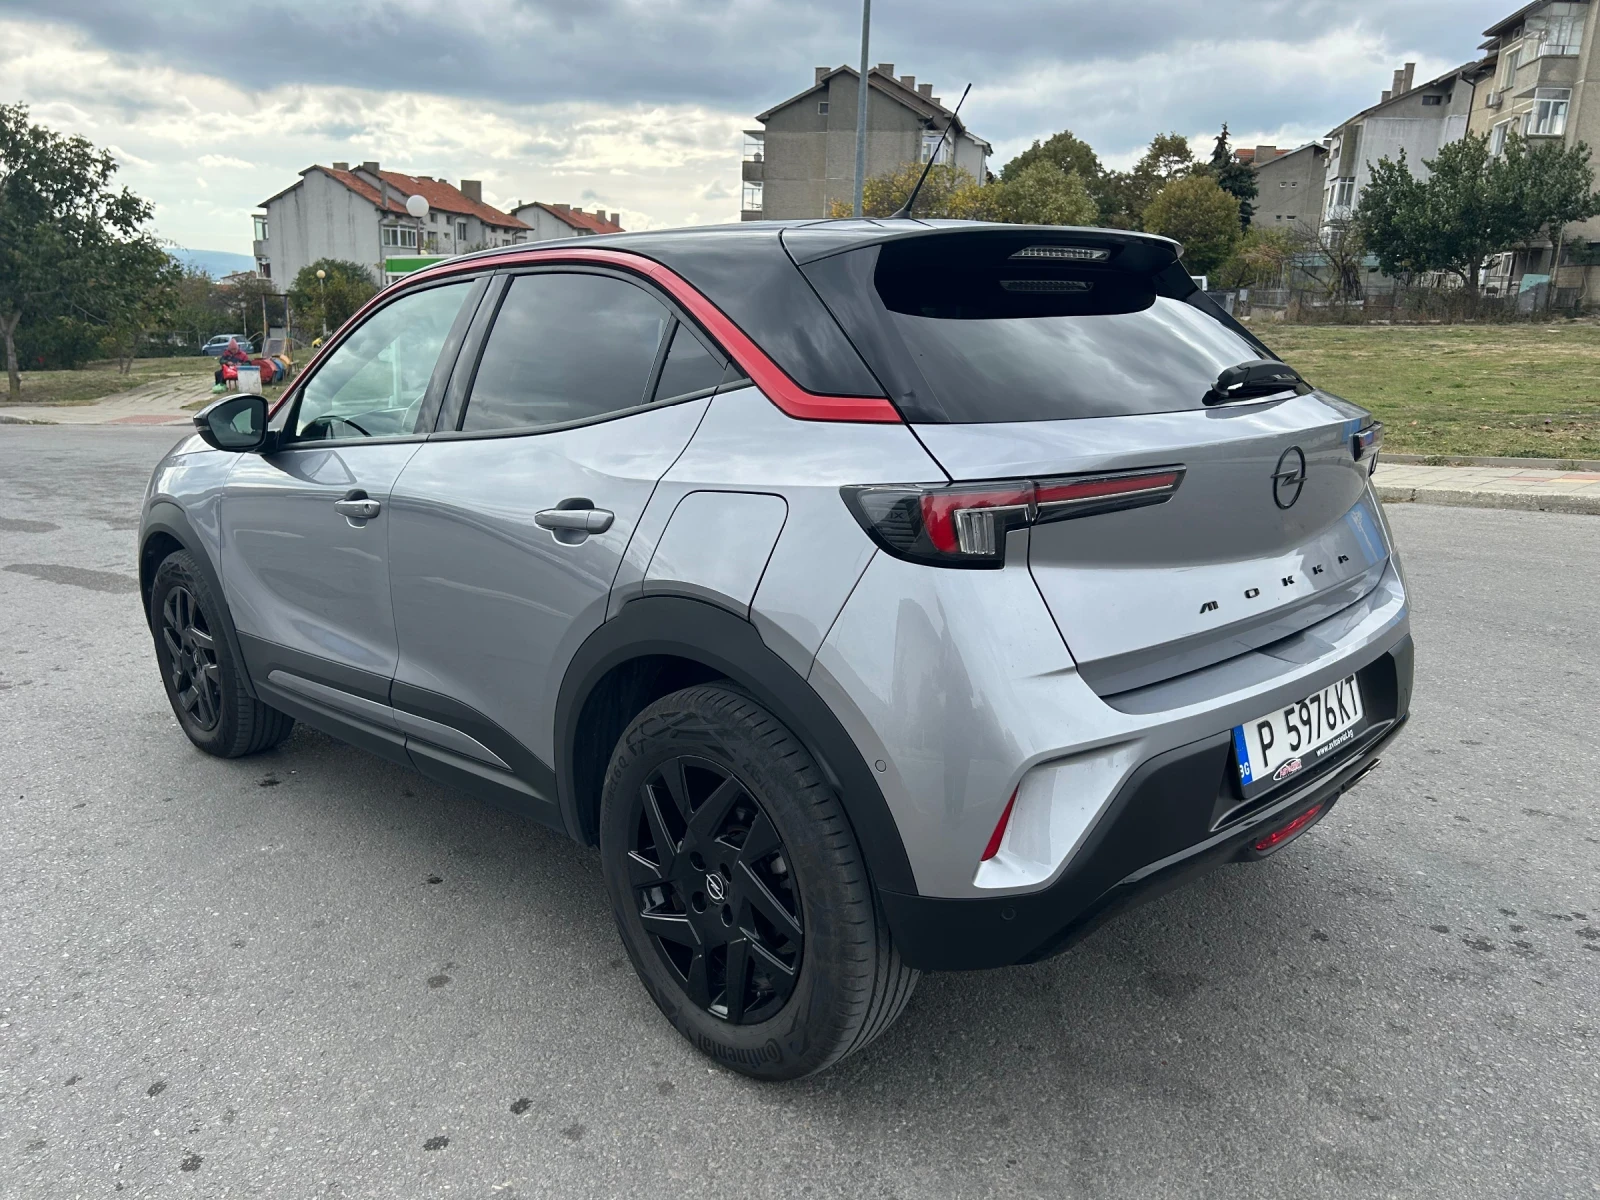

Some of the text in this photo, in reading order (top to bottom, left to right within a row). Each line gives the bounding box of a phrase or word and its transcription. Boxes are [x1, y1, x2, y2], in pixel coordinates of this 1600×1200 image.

[1199, 553, 1350, 615] MOKKA
[1257, 720, 1275, 769] P
[697, 1031, 785, 1069] Continental
